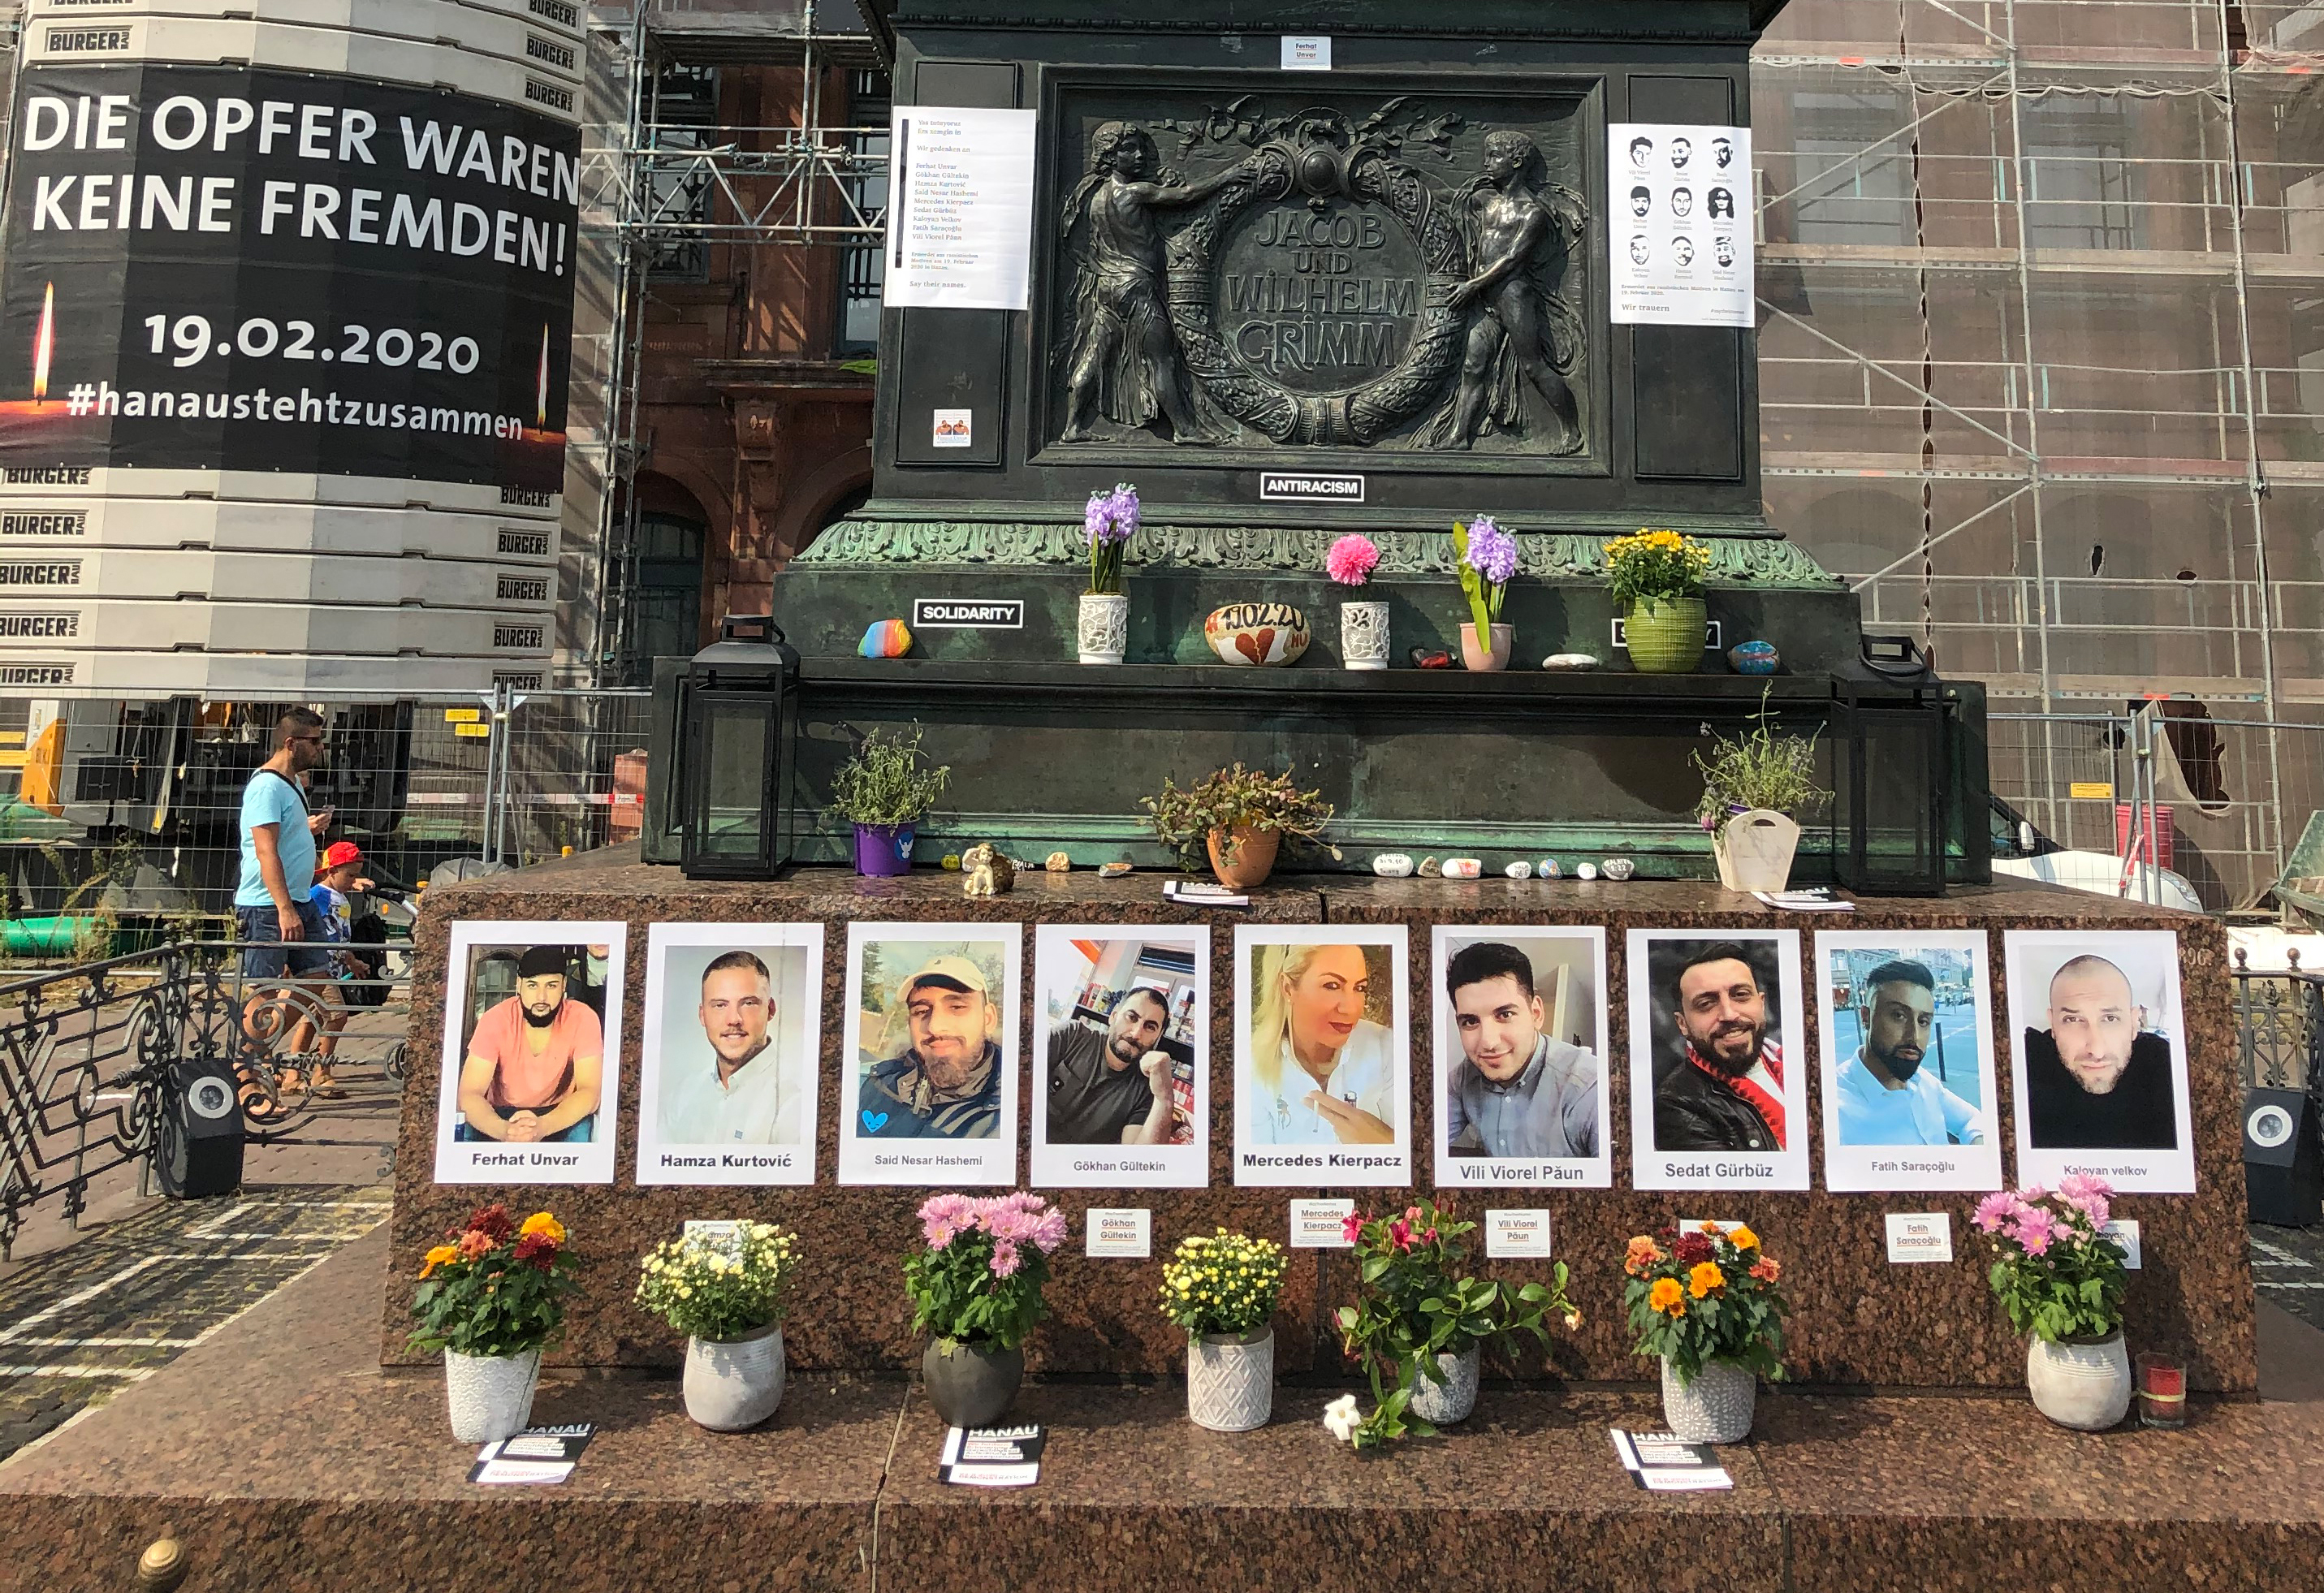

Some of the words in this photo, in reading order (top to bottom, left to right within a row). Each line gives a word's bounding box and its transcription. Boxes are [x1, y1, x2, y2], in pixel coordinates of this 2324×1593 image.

[529, 0, 572, 25] BURGER
[50, 32, 119, 50] BURGER
[526, 37, 568, 68] BURGER
[525, 81, 567, 110] BURGER
[24, 94, 130, 152] DIE
[152, 95, 377, 164] OPFER
[400, 116, 580, 206] WAREN
[32, 174, 235, 233] KEINE
[260, 181, 566, 277] FREMDEN!
[1254, 212, 1386, 249] JACOB
[1292, 252, 1351, 275] UND
[145, 313, 480, 375] 19.02.2020
[66, 382, 522, 441] #hanaustehtzusammen
[7, 468, 80, 485] BURGER
[1266, 478, 1359, 496] ANTIRACISM
[2, 516, 75, 535] BURGER
[499, 534, 542, 555] BURGER
[0, 565, 70, 585] BURGER
[497, 581, 541, 600] BURGER
[922, 606, 1015, 621] SOLIDARITY
[493, 628, 537, 648] BURGER
[472, 1153, 525, 1168] Ferhat
[530, 1153, 579, 1168] Unvar
[661, 1154, 716, 1168] Hamza
[722, 1153, 793, 1168] Kurtović
[875, 1155, 898, 1166] Said
[902, 1155, 933, 1166] Nesar
[935, 1155, 983, 1167] Hashemi
[1073, 1160, 1117, 1172] Gökhan
[1120, 1160, 1166, 1172] Gültekin
[1243, 1154, 1323, 1168] Mercedes
[1329, 1154, 1402, 1171] Kierpacz
[1871, 1161, 1898, 1172] Fatih
[1901, 1160, 1955, 1176] Saraçoğlu
[1460, 1165, 1485, 1181] Vili
[1490, 1165, 1537, 1181] Viorel
[1543, 1163, 1583, 1181] Păun
[1665, 1162, 1709, 1179] Sedat
[1714, 1160, 1773, 1179] Gürbüz
[2063, 1164, 2109, 1179] Kaloyan
[2111, 1165, 2148, 1176] velkov
[1301, 1209, 1344, 1217] Mercedes
[1101, 1218, 1136, 1227] Gökhan
[1303, 1221, 1341, 1230] Kierpacz
[1497, 1220, 1511, 1228] Vili
[1513, 1220, 1538, 1228] Viorel
[1907, 1224, 1929, 1233] Fatih
[1100, 1231, 1137, 1239] Gültekin
[1507, 1231, 1529, 1240] Păun
[1896, 1236, 1942, 1246] Saraçoğlu
[970, 1423, 1039, 1437] HANAU
